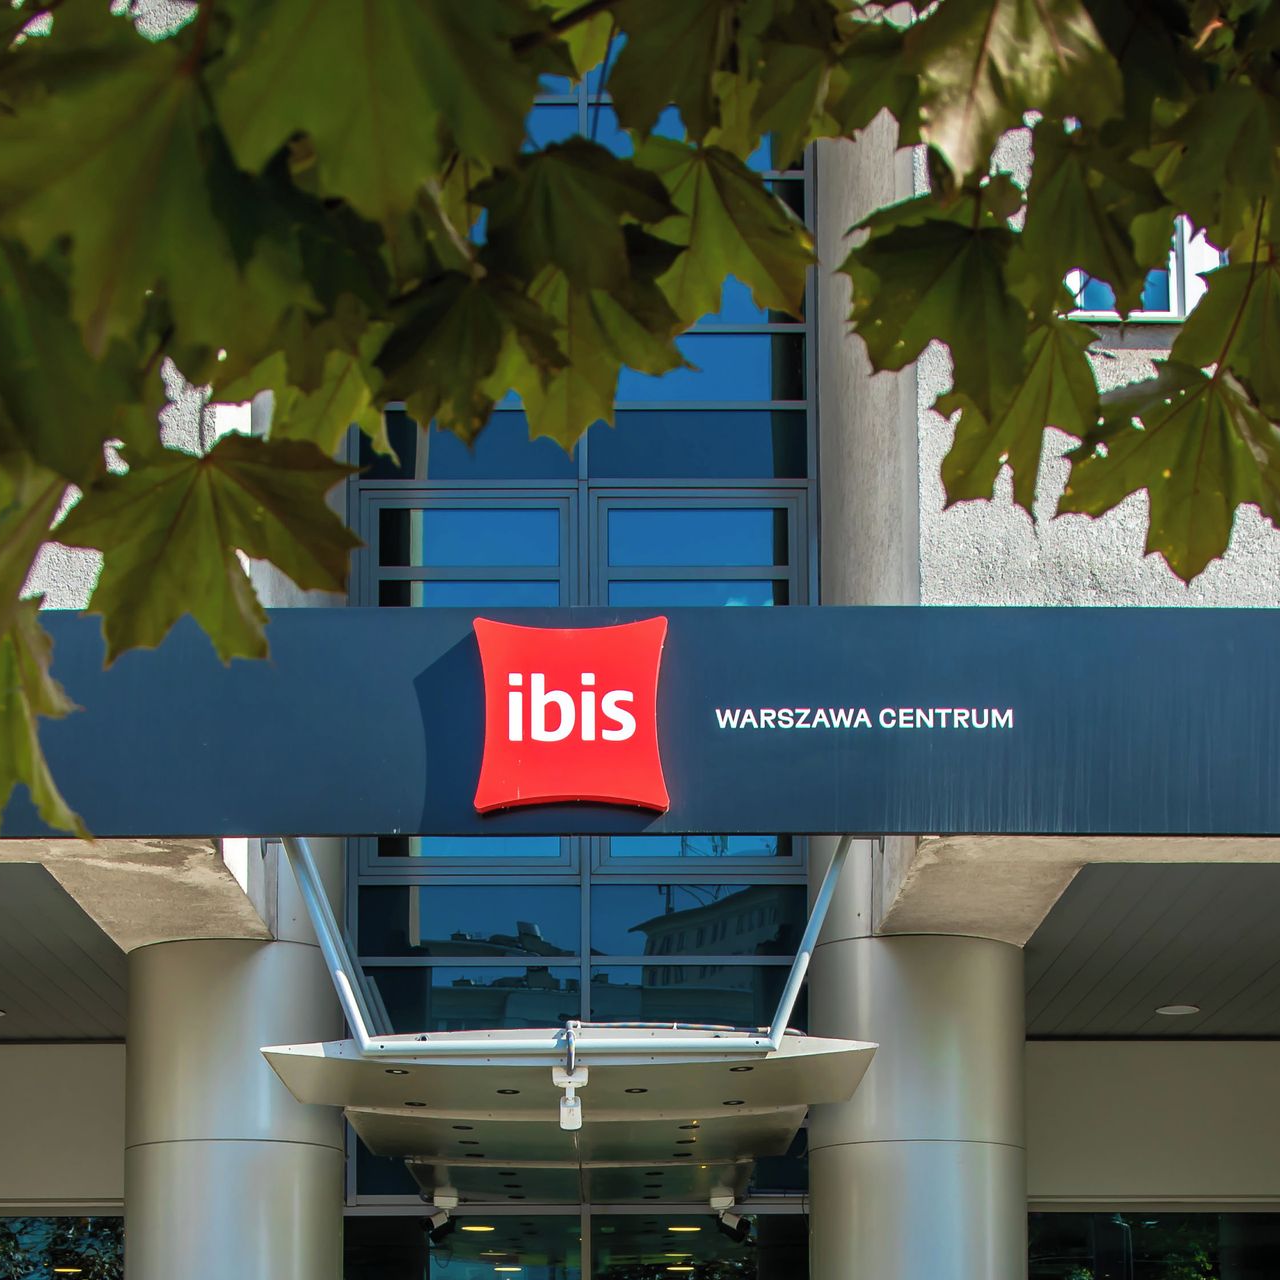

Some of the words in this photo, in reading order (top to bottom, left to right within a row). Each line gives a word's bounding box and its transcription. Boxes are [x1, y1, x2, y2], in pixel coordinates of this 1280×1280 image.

[508, 672, 637, 742] ibis
[716, 707, 872, 729] WARSZAWA
[878, 707, 1014, 729] CENTRUM
